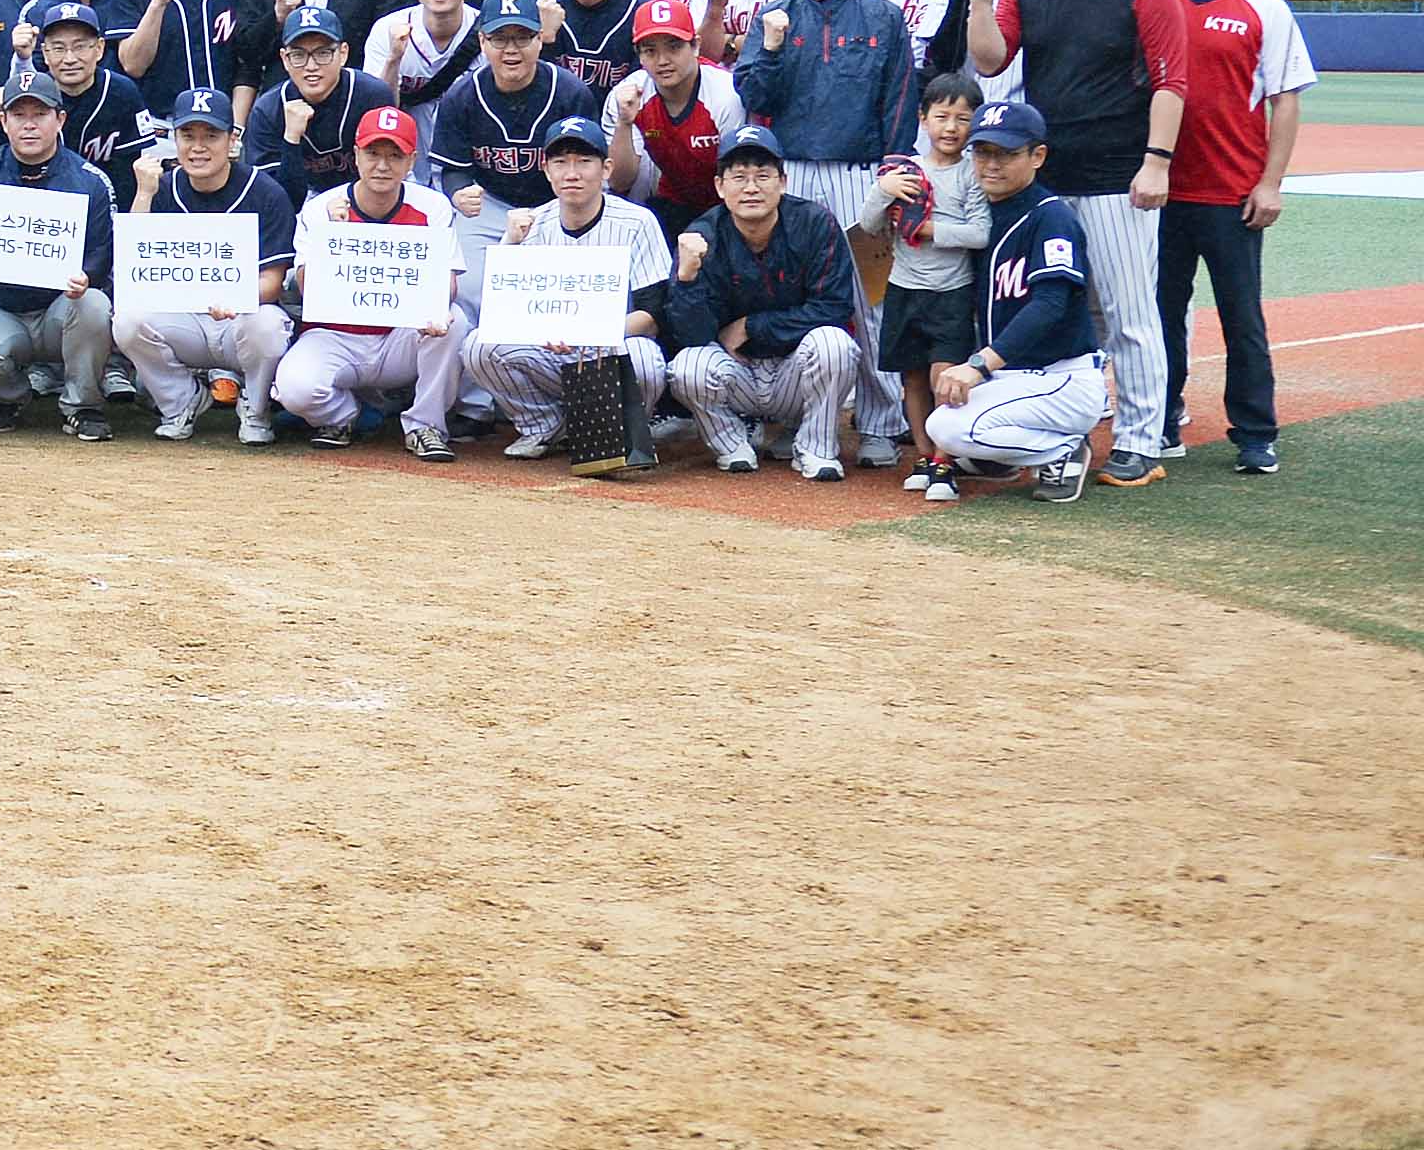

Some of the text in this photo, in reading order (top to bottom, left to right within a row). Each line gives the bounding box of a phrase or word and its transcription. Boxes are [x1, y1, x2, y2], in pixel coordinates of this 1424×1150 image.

[651, 1, 671, 22] G
[1204, 17, 1248, 36] KTR
[379, 109, 397, 130] G
[137, 241, 234, 260] 한국전력기술
[328, 237, 429, 260] 한국화학융합
[131, 266, 242, 283] (KEPCO E&C)
[335, 265, 419, 286] 시험연구원
[490, 273, 622, 293] 한국산업기술진흥원
[352, 291, 400, 310] (KTR)
[527, 298, 579, 317] (KIAT)
